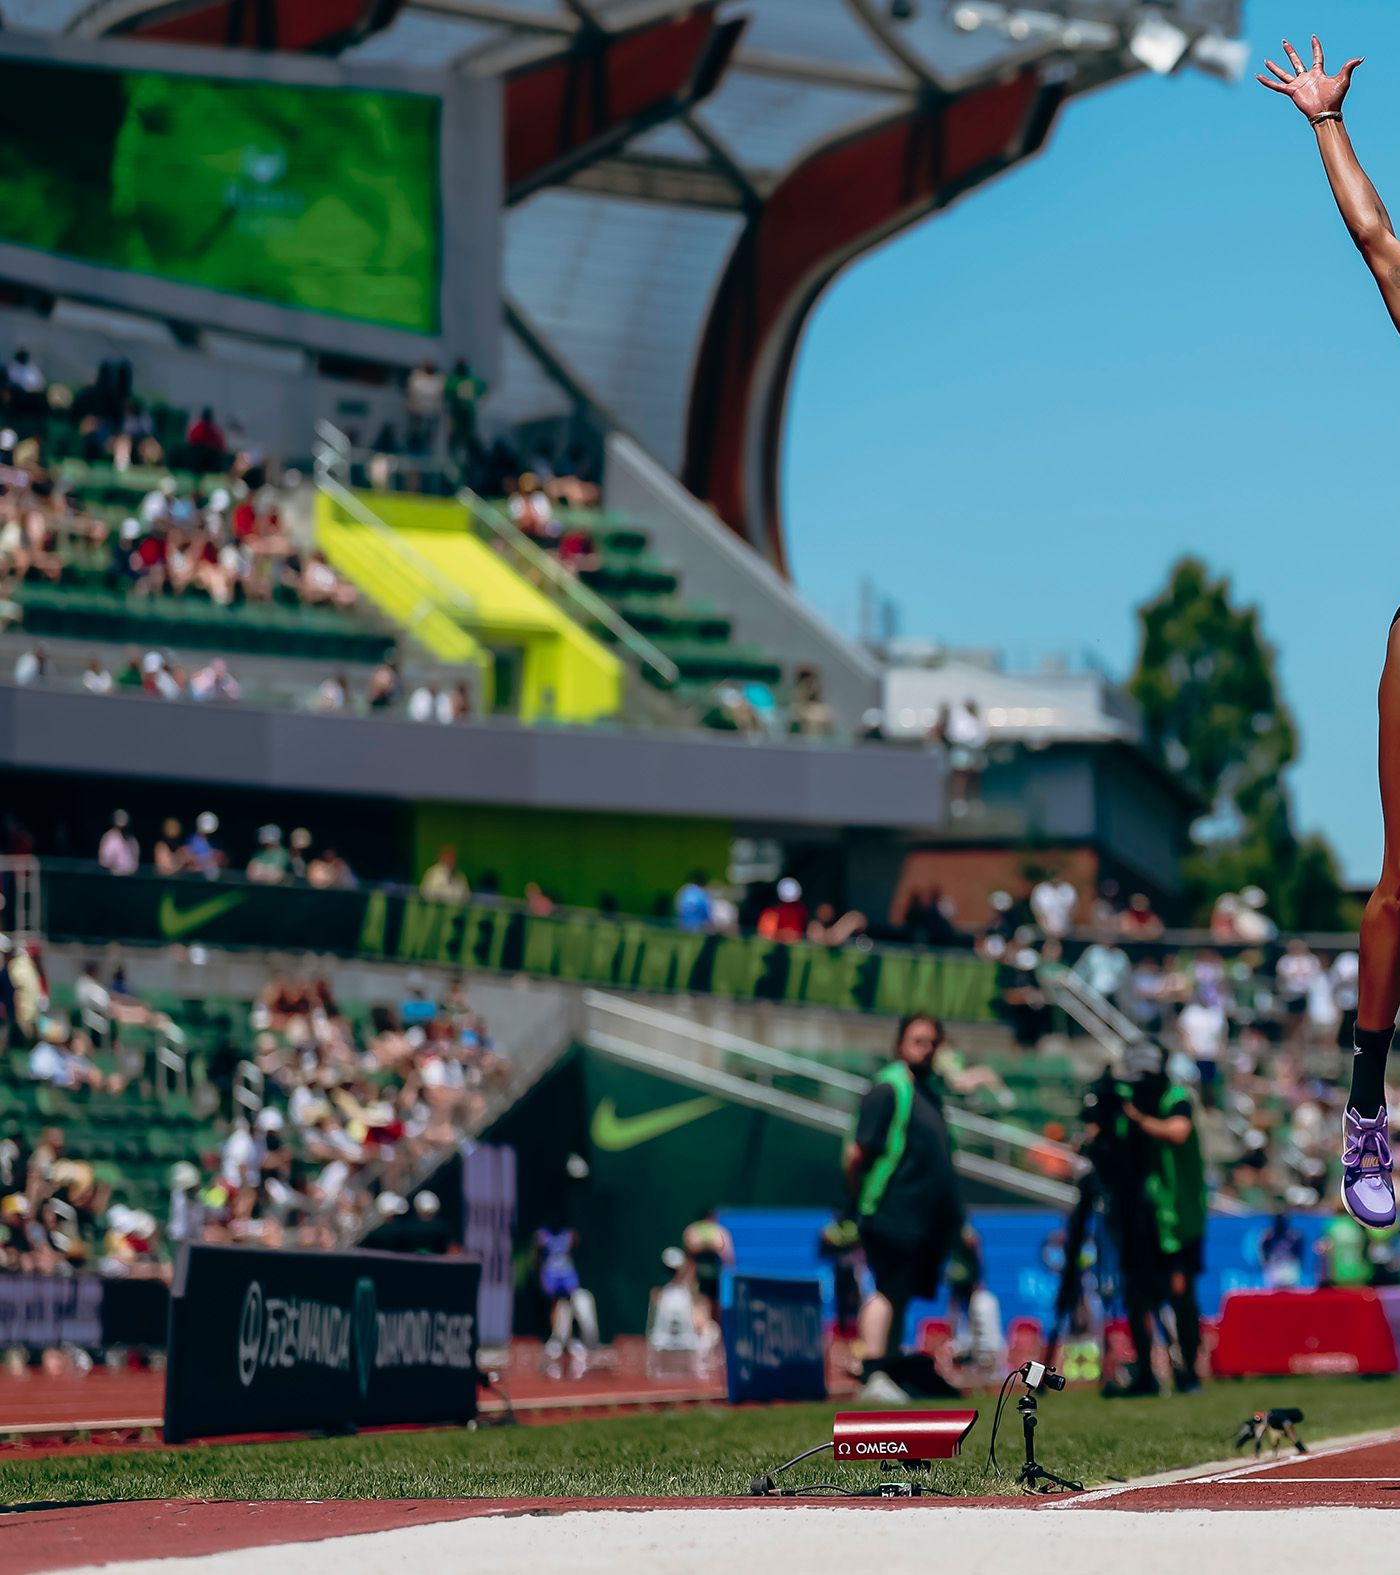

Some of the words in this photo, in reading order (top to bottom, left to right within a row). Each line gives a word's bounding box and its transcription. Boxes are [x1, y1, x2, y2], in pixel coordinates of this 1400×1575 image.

[402, 894, 515, 970] MEET
[710, 936, 776, 1003] OF
[786, 946, 867, 1010] THE
[876, 953, 998, 1023] NAME
[298, 1301, 350, 1368] WANDA
[855, 1442, 908, 1454] OMEGA
